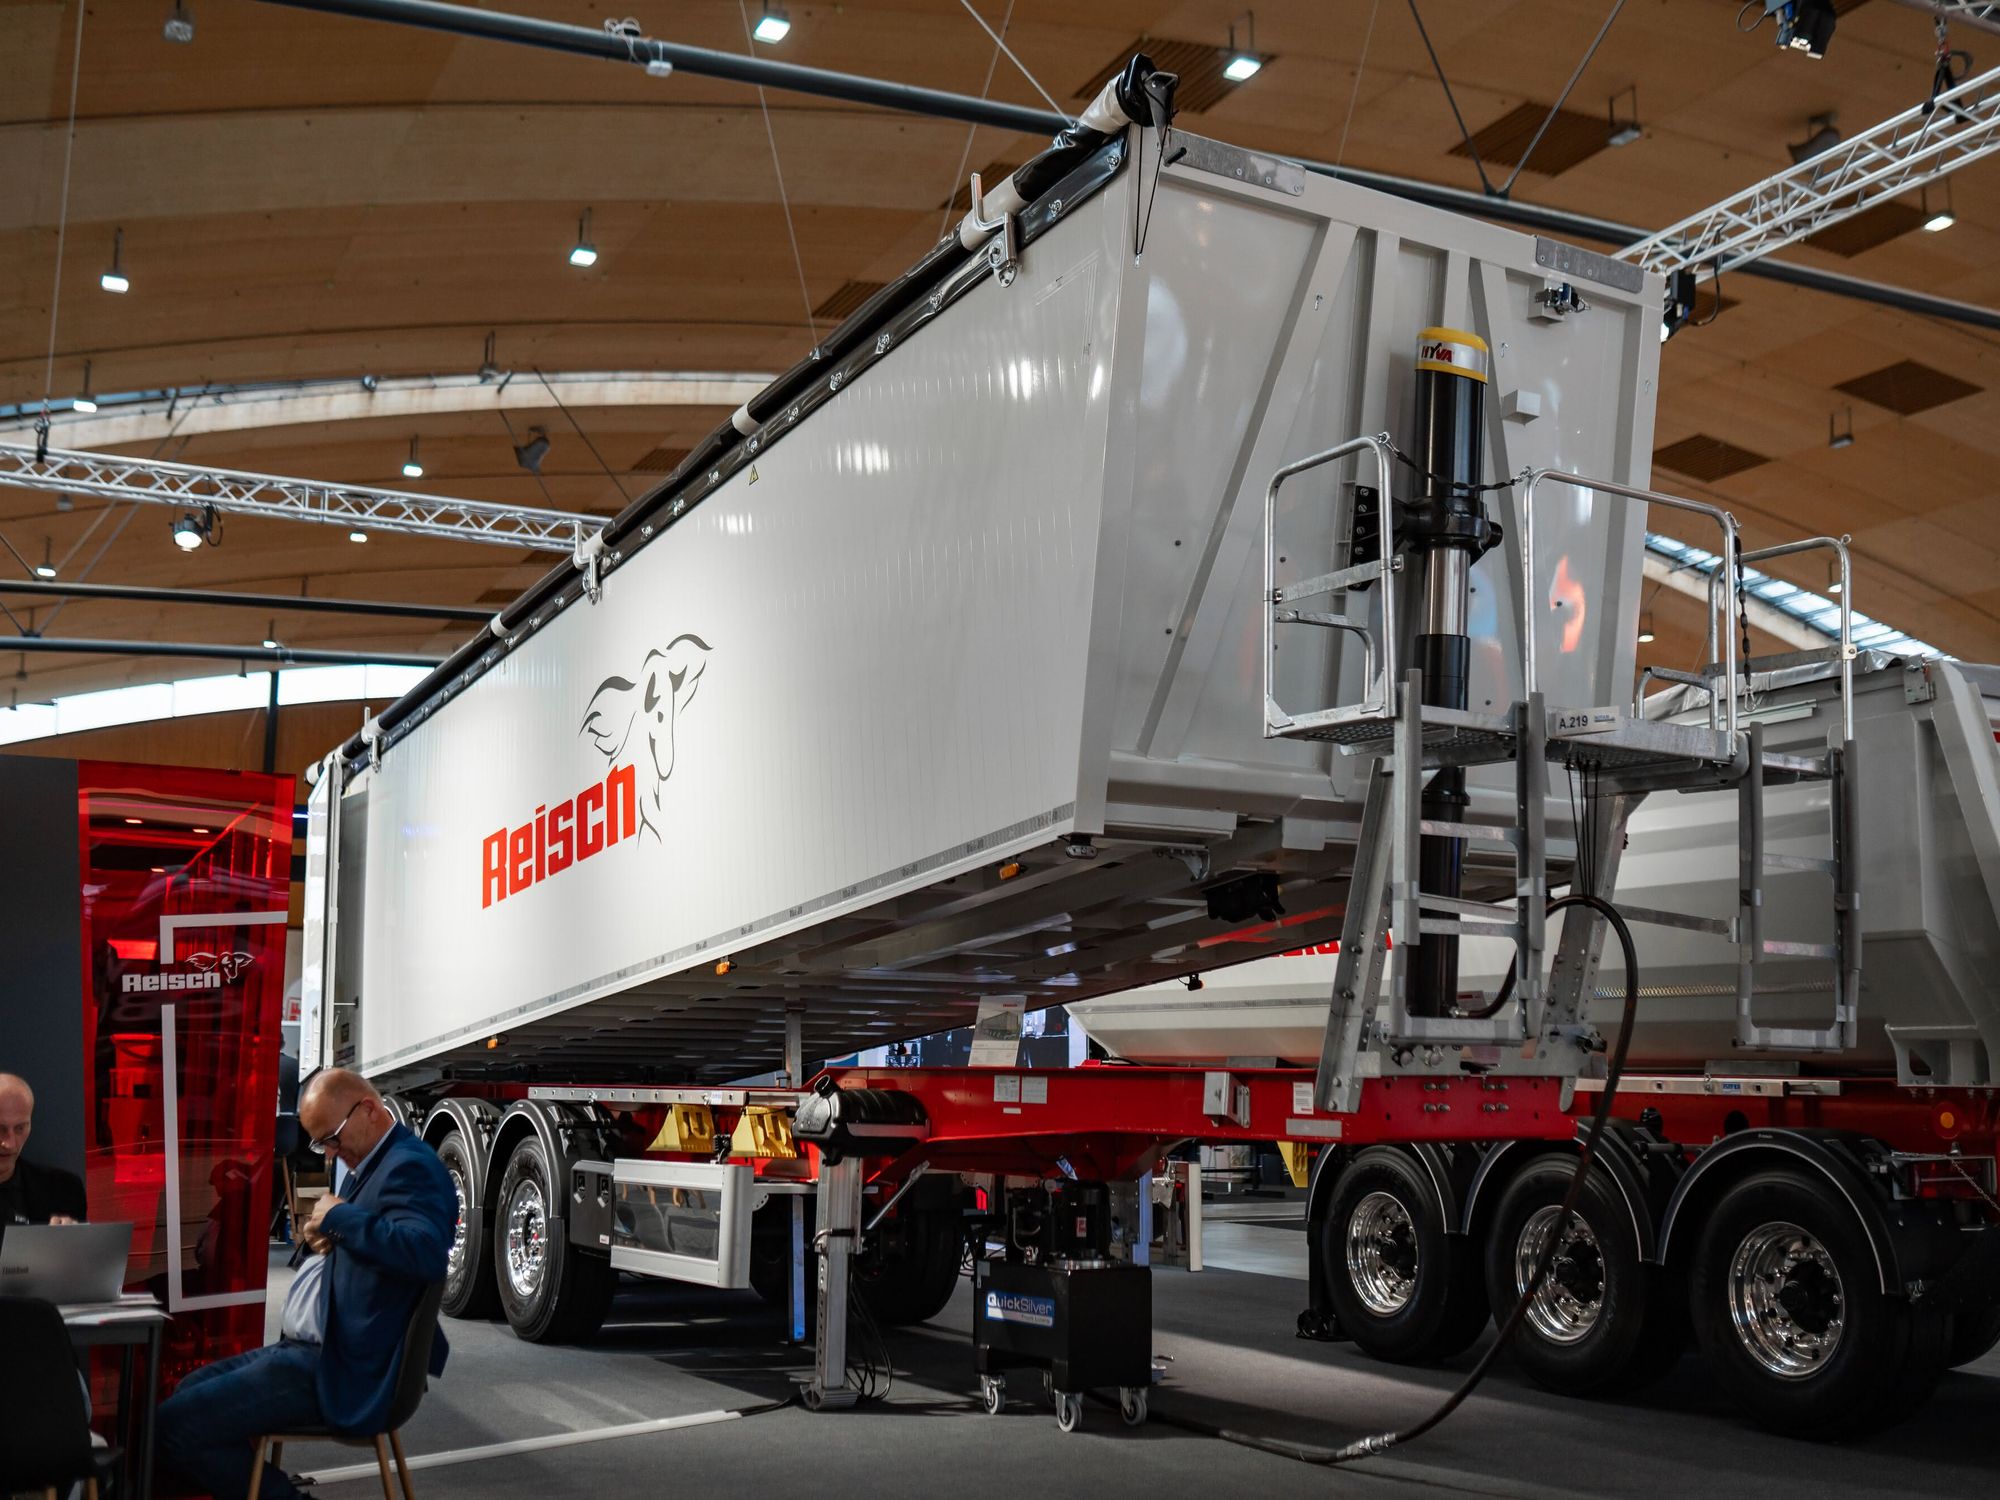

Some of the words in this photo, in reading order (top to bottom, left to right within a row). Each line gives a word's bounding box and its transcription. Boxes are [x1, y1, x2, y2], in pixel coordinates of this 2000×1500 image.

[1560, 715, 1588, 729] A.219
[482, 763, 636, 910] Reisch
[121, 972, 221, 992] Reisch
[987, 1291, 1053, 1315] QuickSilver
